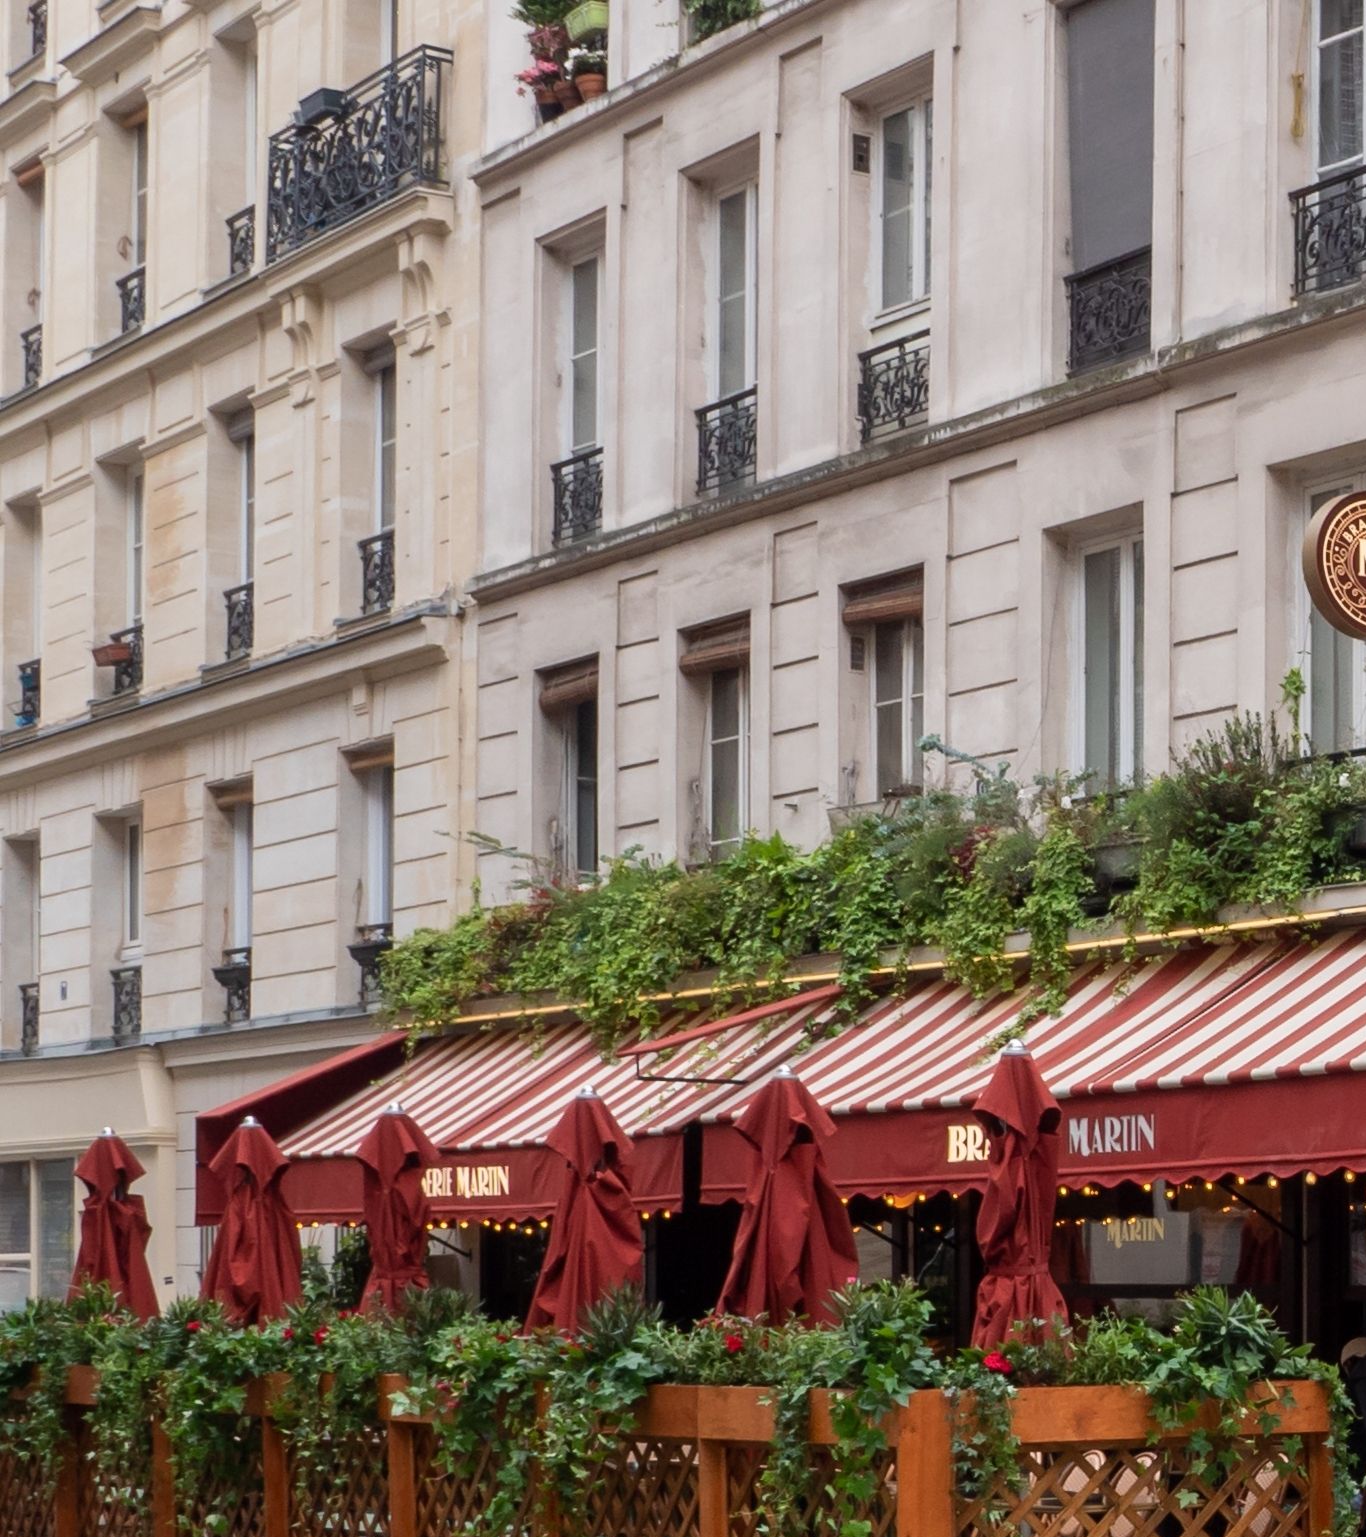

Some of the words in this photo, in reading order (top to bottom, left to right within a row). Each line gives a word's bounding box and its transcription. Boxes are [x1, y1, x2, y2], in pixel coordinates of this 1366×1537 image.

[1068, 1113, 1156, 1157] MARTIN
[456, 1166, 510, 1199] MARTIN
[1107, 1217, 1165, 1249] MARTIN
